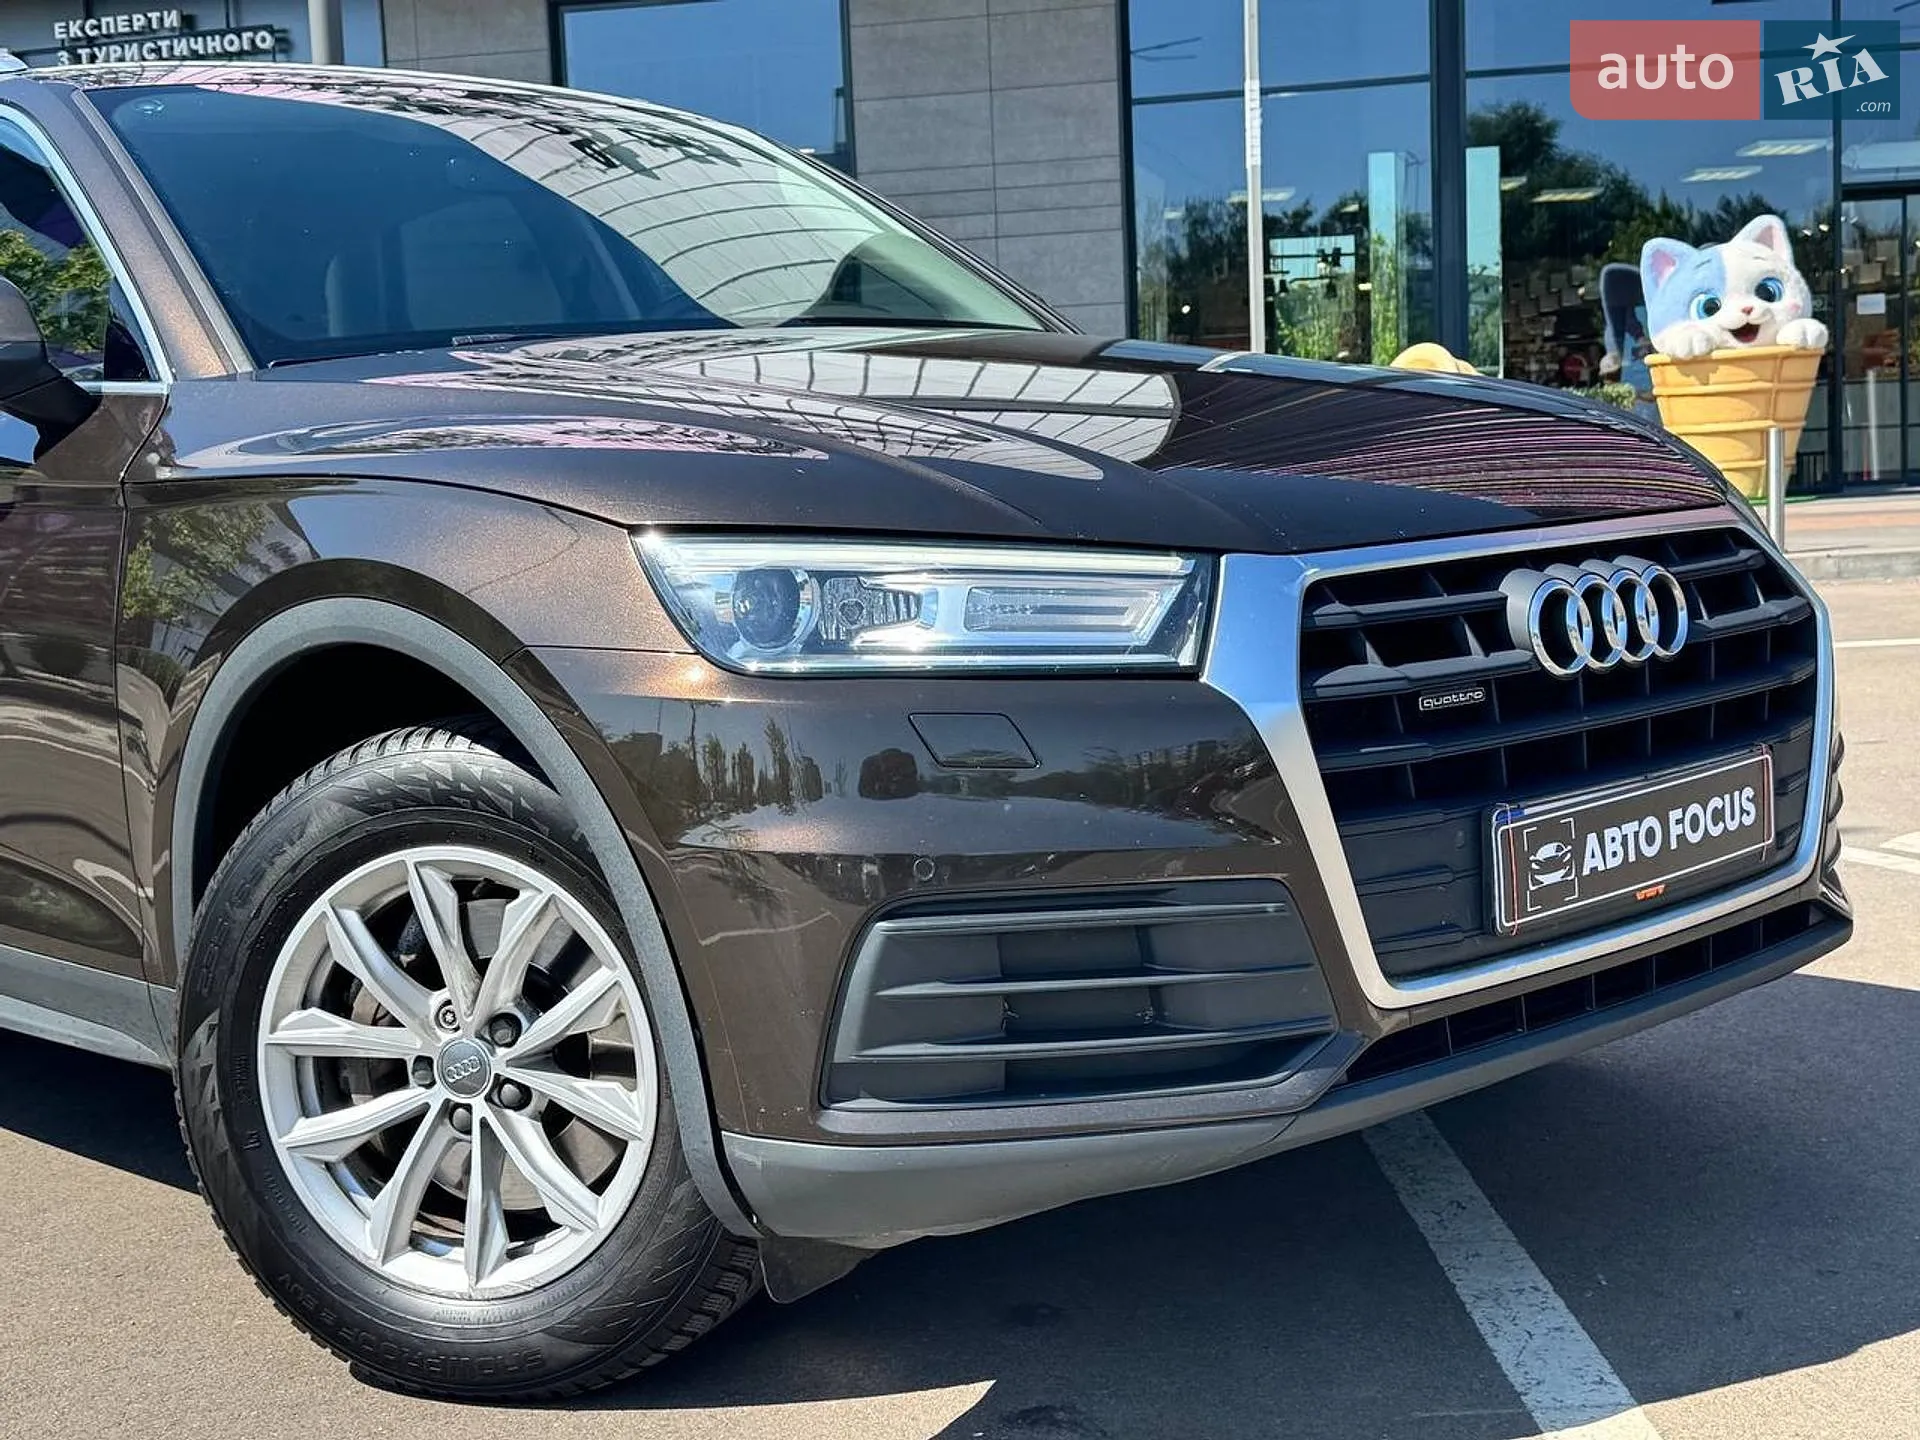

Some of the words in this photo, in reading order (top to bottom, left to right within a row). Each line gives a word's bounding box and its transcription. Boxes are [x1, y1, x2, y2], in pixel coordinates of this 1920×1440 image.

[53, 10, 180, 40] ЕКСПЕРТИ
[76, 30, 275, 64] ТУРИСТИЧНОГО
[1423, 691, 1484, 708] quattro
[1668, 786, 1756, 850] FOCUS
